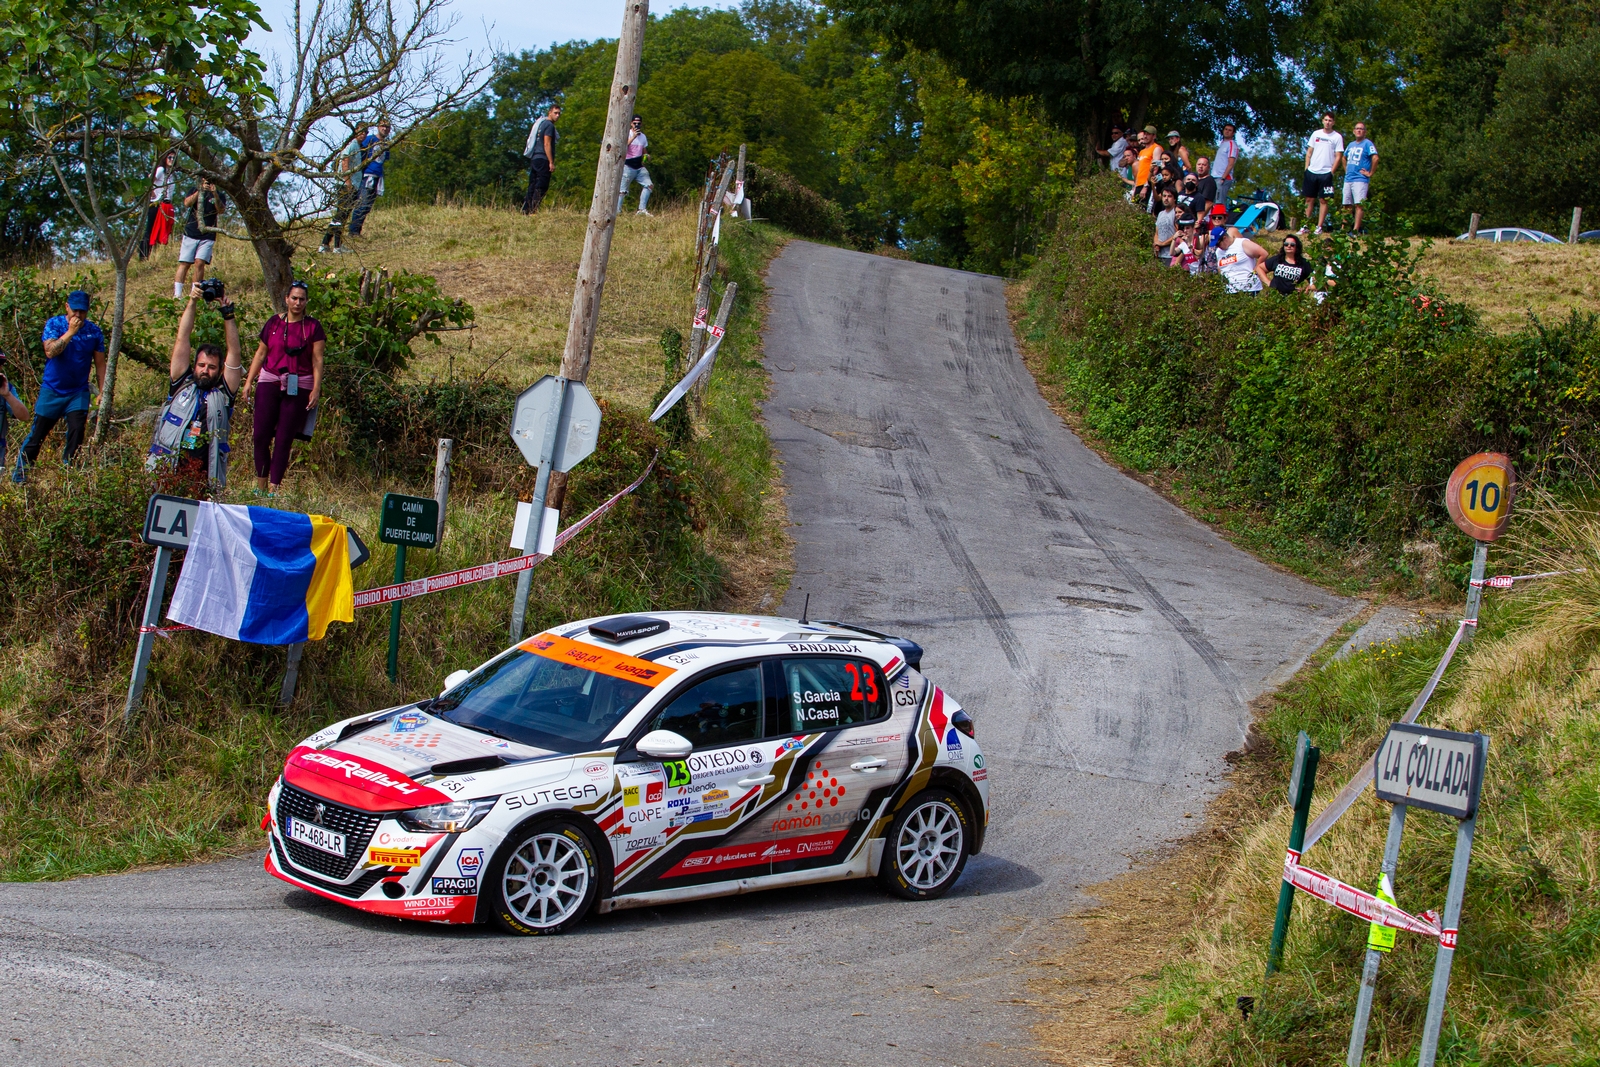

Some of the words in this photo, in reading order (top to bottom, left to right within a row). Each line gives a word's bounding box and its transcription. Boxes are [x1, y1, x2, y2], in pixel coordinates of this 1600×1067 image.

[1465, 480, 1500, 513] 10
[402, 501, 424, 514] CAMÍN
[151, 505, 188, 538] LA
[406, 516, 416, 527] DE
[385, 527, 410, 540] PUERTE
[411, 531, 434, 543] CAMPU
[382, 584, 411, 601] PUBLICO
[427, 573, 458, 591] PROHIBIDO
[459, 568, 483, 584] PUBLICO
[497, 557, 527, 577] PROHIBIDO
[636, 624, 660, 634] SPORT
[788, 643, 862, 653] BANDALUX
[668, 654, 691, 665] GSI
[844, 663, 879, 703] 23
[793, 689, 841, 704] S.Garcia
[895, 690, 918, 706] GSI
[796, 706, 839, 721] N.Casal
[688, 749, 746, 772] OVIEDO
[947, 750, 964, 761] ONE
[663, 760, 691, 788] 23
[1383, 740, 1402, 783] LA
[1405, 743, 1472, 798] COLLADA
[441, 780, 465, 793] GSI
[624, 787, 639, 796] RACC
[505, 784, 598, 811] SUTEGA
[667, 797, 690, 808] ROXU
[294, 821, 341, 853] FP-468-LR
[626, 836, 658, 849] TOPTUL
[370, 851, 418, 864] PIRELLI
[461, 856, 479, 865] ICA
[443, 878, 476, 889] PAGID
[404, 900, 427, 908] WIND
[427, 897, 455, 907] ONE
